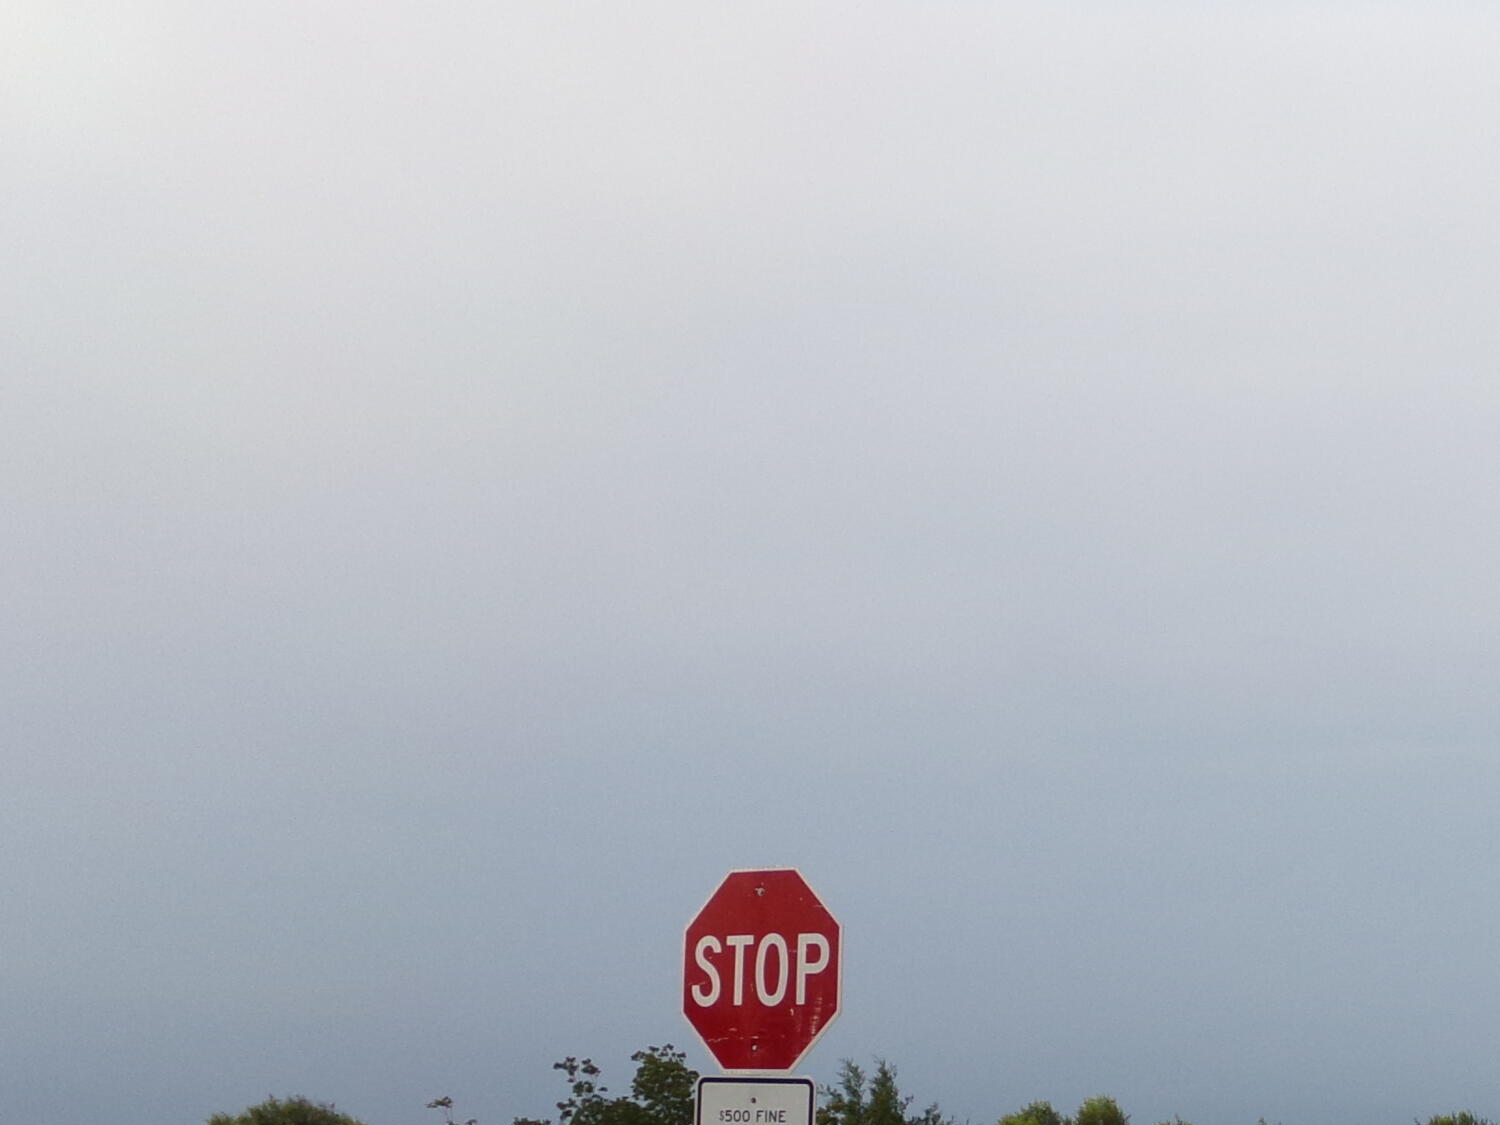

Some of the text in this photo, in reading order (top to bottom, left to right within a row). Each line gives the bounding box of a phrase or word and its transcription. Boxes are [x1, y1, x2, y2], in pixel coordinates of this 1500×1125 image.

[691, 932, 830, 1008] STOP
[719, 1109, 787, 1123] $500 FINE
